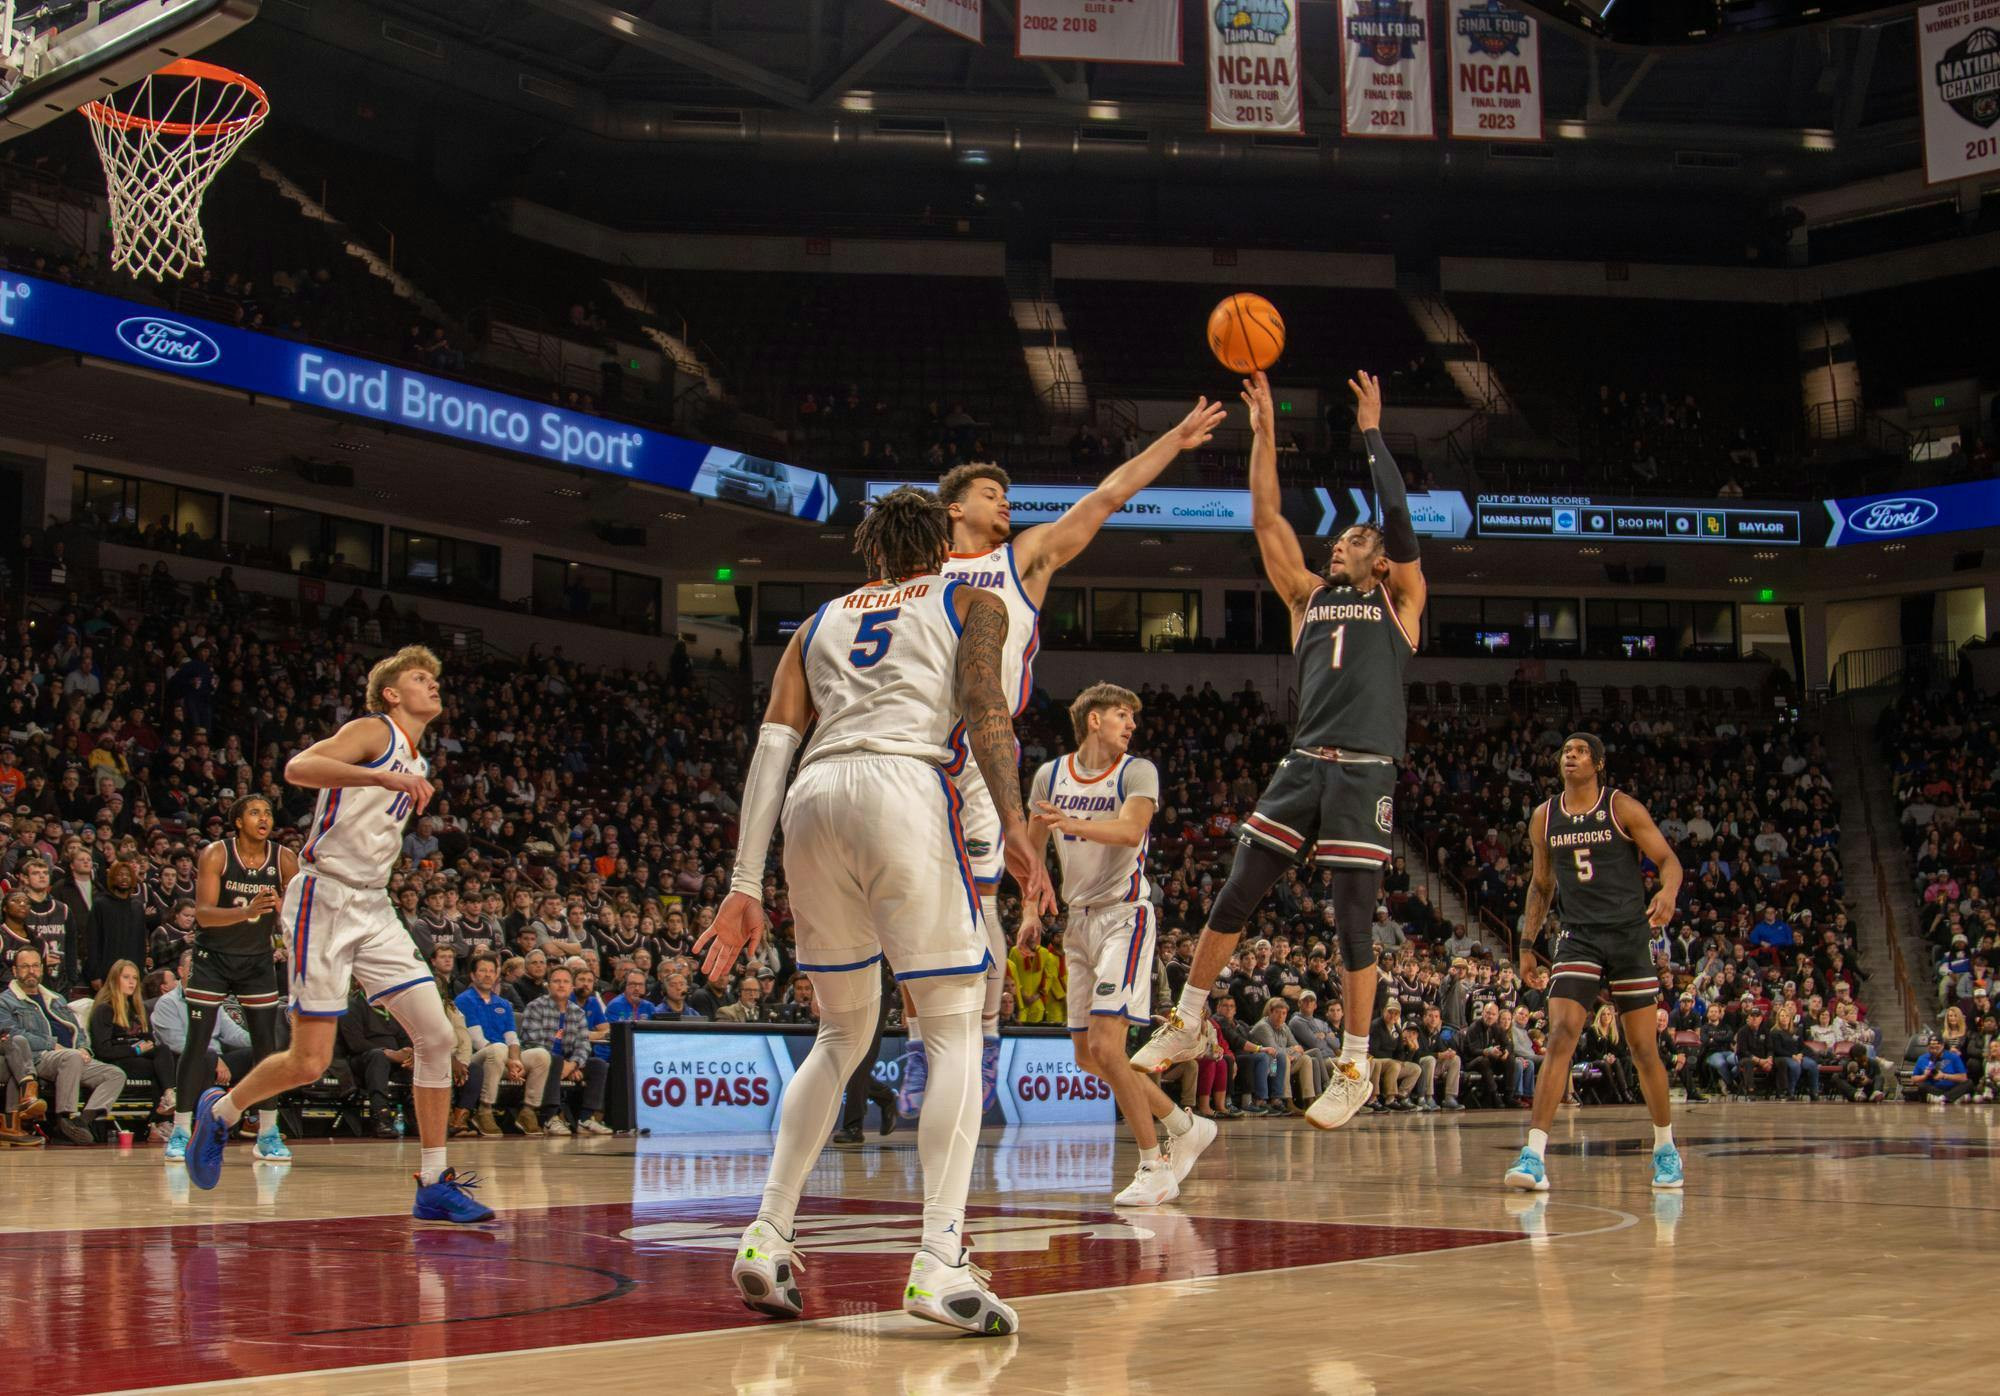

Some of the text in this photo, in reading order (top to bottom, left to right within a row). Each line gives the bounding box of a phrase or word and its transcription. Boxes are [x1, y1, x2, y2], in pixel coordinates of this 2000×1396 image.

[1023, 15, 1098, 33] 2002 2018
[1351, 22, 1420, 37] FINAL FOUR
[1458, 18, 1528, 34] FINAL FOUR
[1218, 56, 1290, 87] NCAA
[1459, 63, 1532, 95] NCAA
[1372, 73, 1404, 87] NCAA
[1229, 89, 1280, 101] FINAL FOUR
[1364, 90, 1413, 101] FINAL FOUR
[1471, 96, 1522, 109] FINAL FOUR
[1236, 106, 1274, 122] 2015
[1371, 111, 1406, 127] 2021
[1478, 114, 1516, 130] 2023
[136, 322, 200, 361] Ford
[299, 352, 388, 412] Ford
[402, 376, 531, 443] Bronco
[1478, 494, 1591, 506] OUT OF TOWN SCORES
[1136, 504, 1161, 514] BY:
[1172, 507, 1234, 518] Colonial Life
[1865, 502, 1920, 529] Ford
[1429, 513, 1446, 523] Life
[1482, 514, 1552, 526] KANSAS STATE
[1591, 515, 1604, 529] 0
[1617, 517, 1663, 529] 9:00 PM
[1676, 517, 1689, 532] 0
[1738, 521, 1784, 534] BAYLOR
[843, 584, 929, 609] RICHARD
[1307, 604, 1382, 622] GAMECOCKS
[848, 607, 901, 668] 5
[1330, 625, 1345, 669] 1
[1054, 795, 1116, 812] FLORIDA
[1550, 829, 1612, 847] GAMECOCKS
[1573, 848, 1594, 882] 5
[653, 1061, 758, 1075] GAMECOCK
[641, 1076, 770, 1107] GO PASS
[1018, 1075, 1111, 1101] GO PASS
